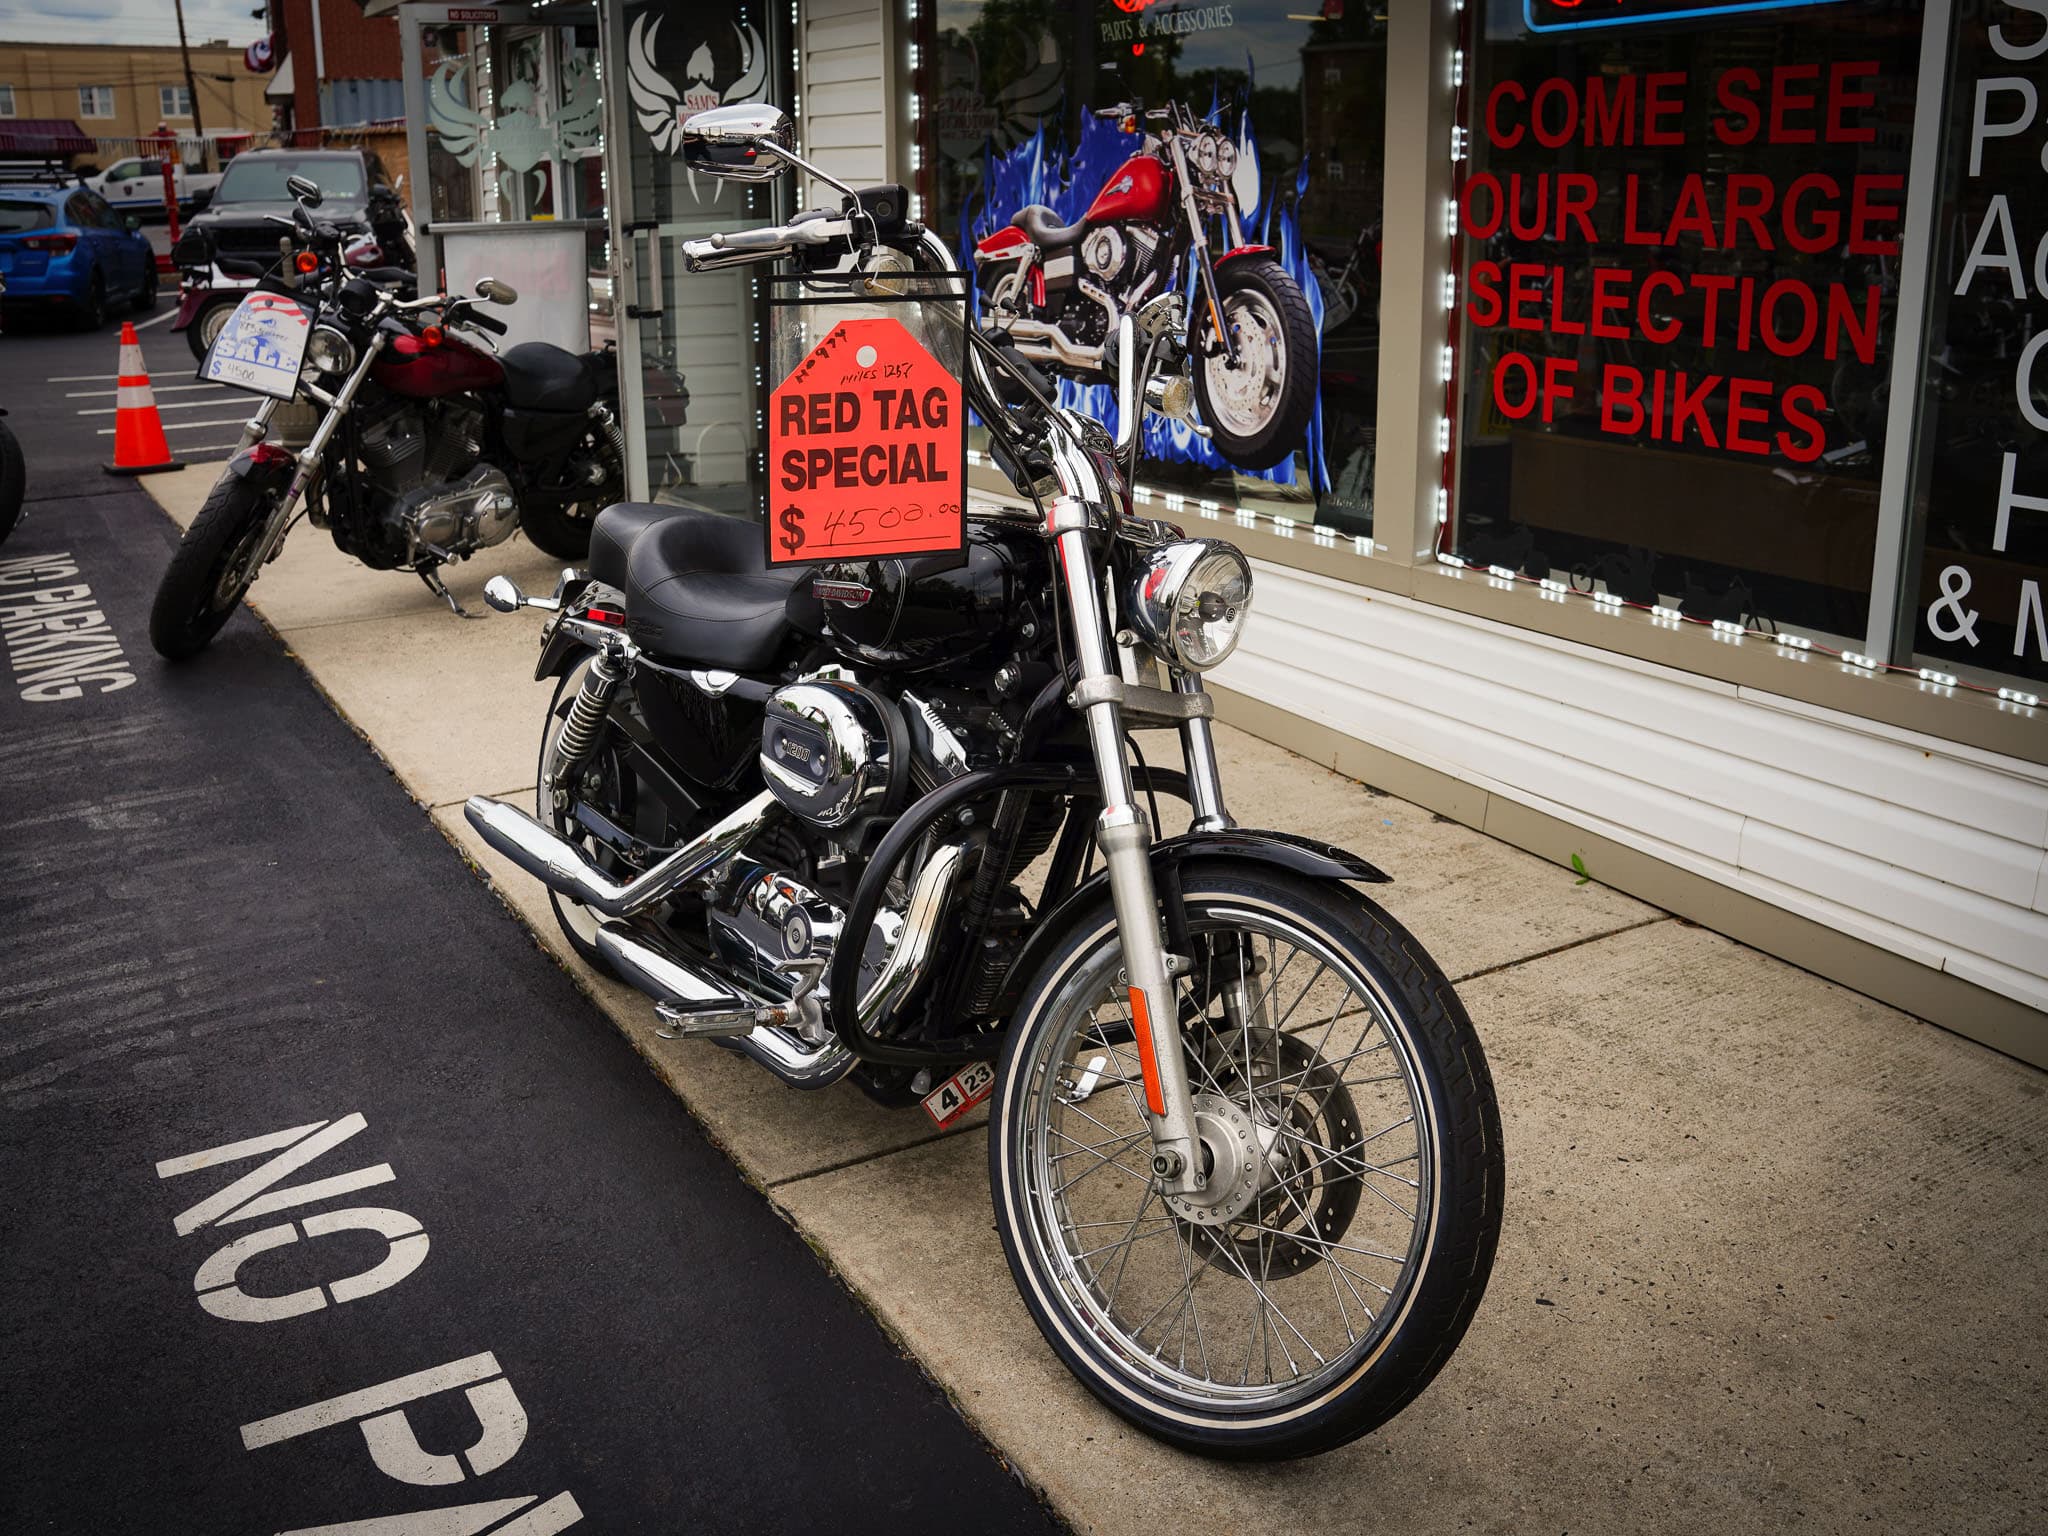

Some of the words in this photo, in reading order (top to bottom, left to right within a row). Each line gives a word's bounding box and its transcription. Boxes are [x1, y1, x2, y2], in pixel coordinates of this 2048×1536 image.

[1101, 19, 1134, 43] PARTS
[1138, 16, 1149, 38] &
[1153, 3, 1235, 36] ACCESSORIES
[686, 94, 718, 111] SAM'S
[1485, 71, 1688, 149] COME
[1713, 61, 1881, 145] SEE
[1459, 171, 1599, 243] OUR
[1624, 173, 1905, 257] LARGE
[1466, 260, 1882, 365] SELECTION
[211, 360, 222, 376] $
[227, 362, 256, 381] 4500
[215, 339, 298, 373] SALE
[780, 391, 862, 437] RED
[873, 386, 949, 431] TAG
[1492, 351, 1580, 424] OF
[1600, 363, 1828, 463] BIKES
[780, 442, 949, 492] SPECIAL
[779, 503, 806, 556] $
[0, 552, 80, 586] NO
[1926, 564, 1980, 648] &
[0, 583, 137, 703] PARKING
[940, 1086, 961, 1111] 4
[963, 1065, 992, 1094] 23
[155, 1111, 431, 1324] NO
